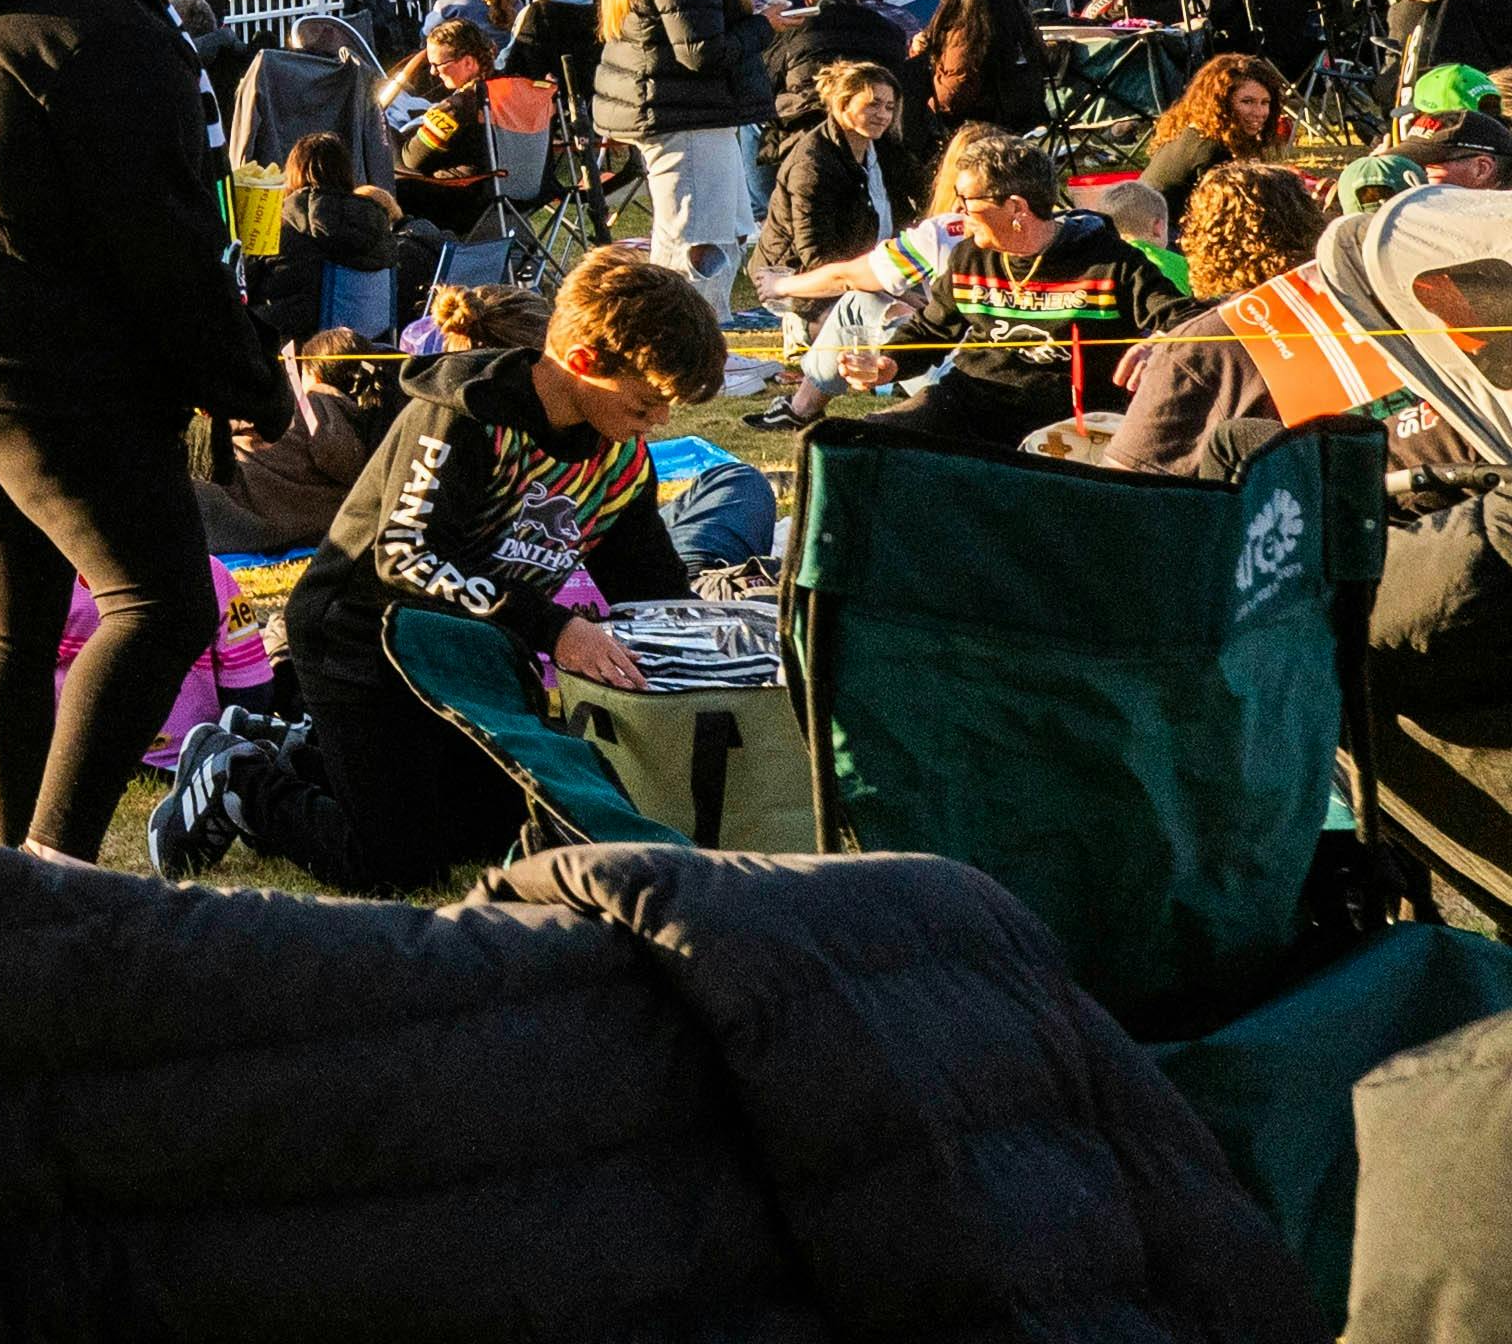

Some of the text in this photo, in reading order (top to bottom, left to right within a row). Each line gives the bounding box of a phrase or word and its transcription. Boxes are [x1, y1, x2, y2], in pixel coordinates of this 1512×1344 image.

[254, 204, 265, 223] HOT
[971, 285, 1088, 311] PANTHERS
[1246, 303, 1295, 360] westfund
[385, 435, 496, 615] PANTHERS
